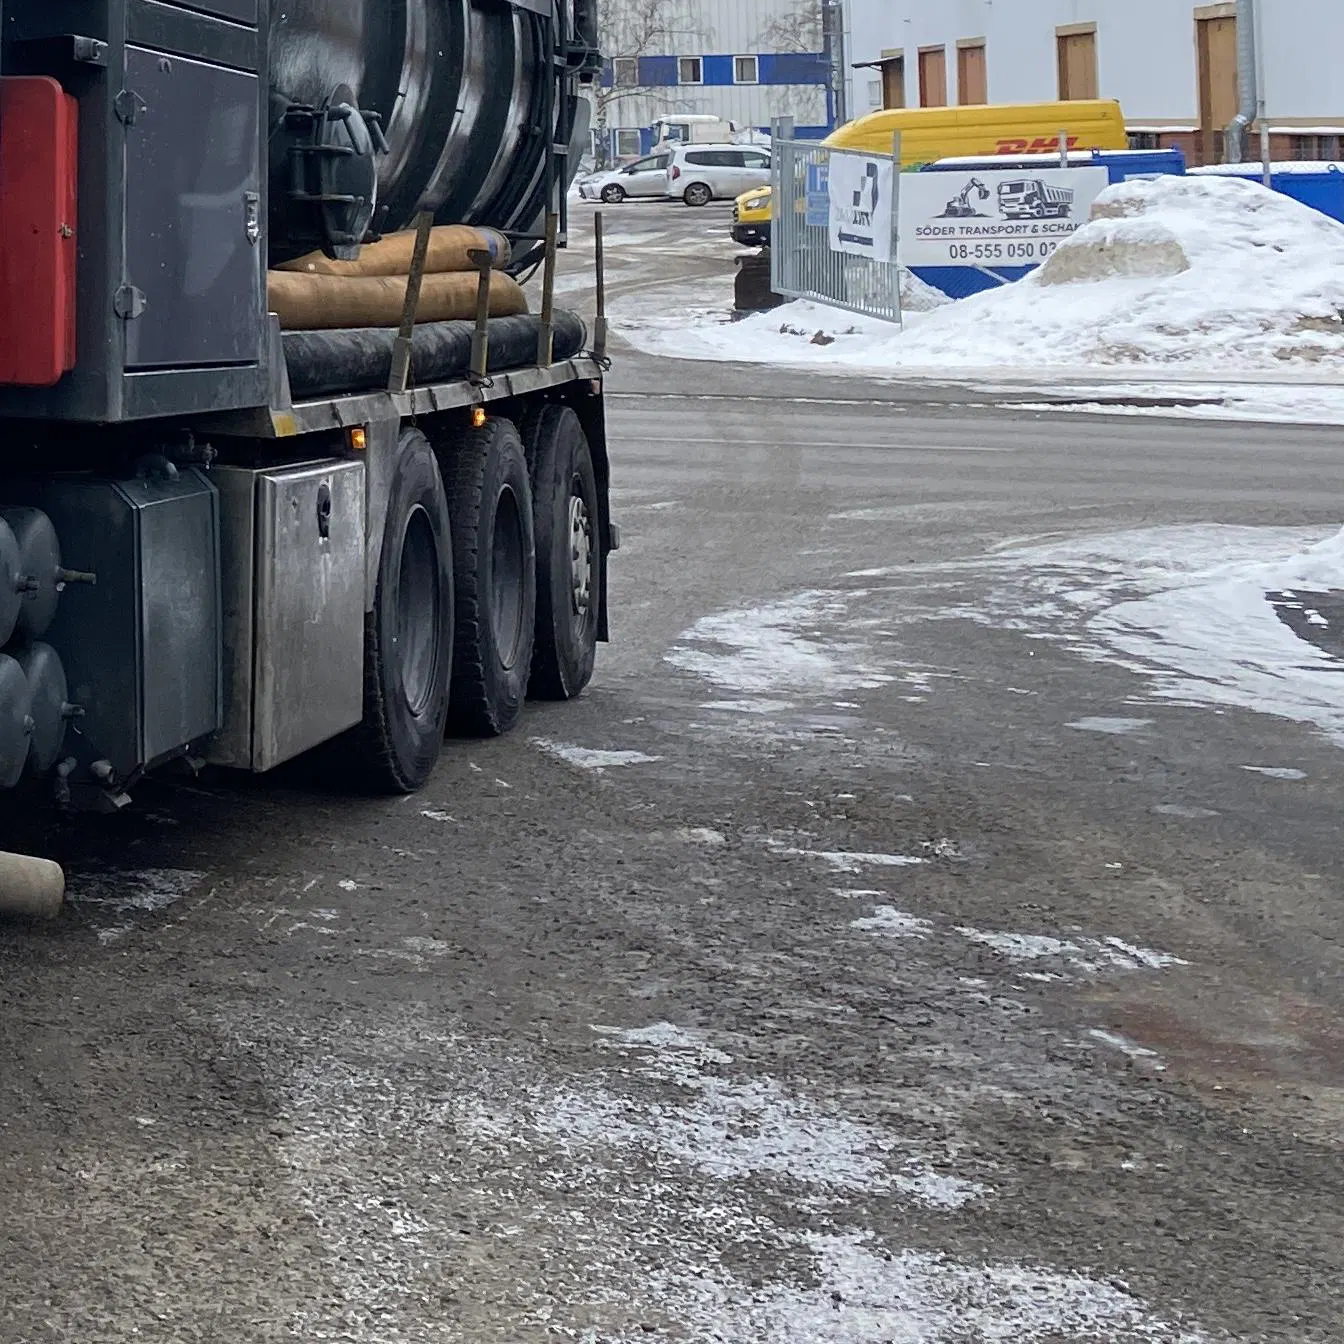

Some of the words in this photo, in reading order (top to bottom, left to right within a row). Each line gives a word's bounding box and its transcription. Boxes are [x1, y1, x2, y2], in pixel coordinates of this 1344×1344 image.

[915, 224, 955, 236] SÖDER
[958, 224, 1029, 235] TRANSPORT
[1030, 224, 1039, 234] &
[949, 244, 1002, 259] 08-555
[1007, 242, 1034, 258] 050
